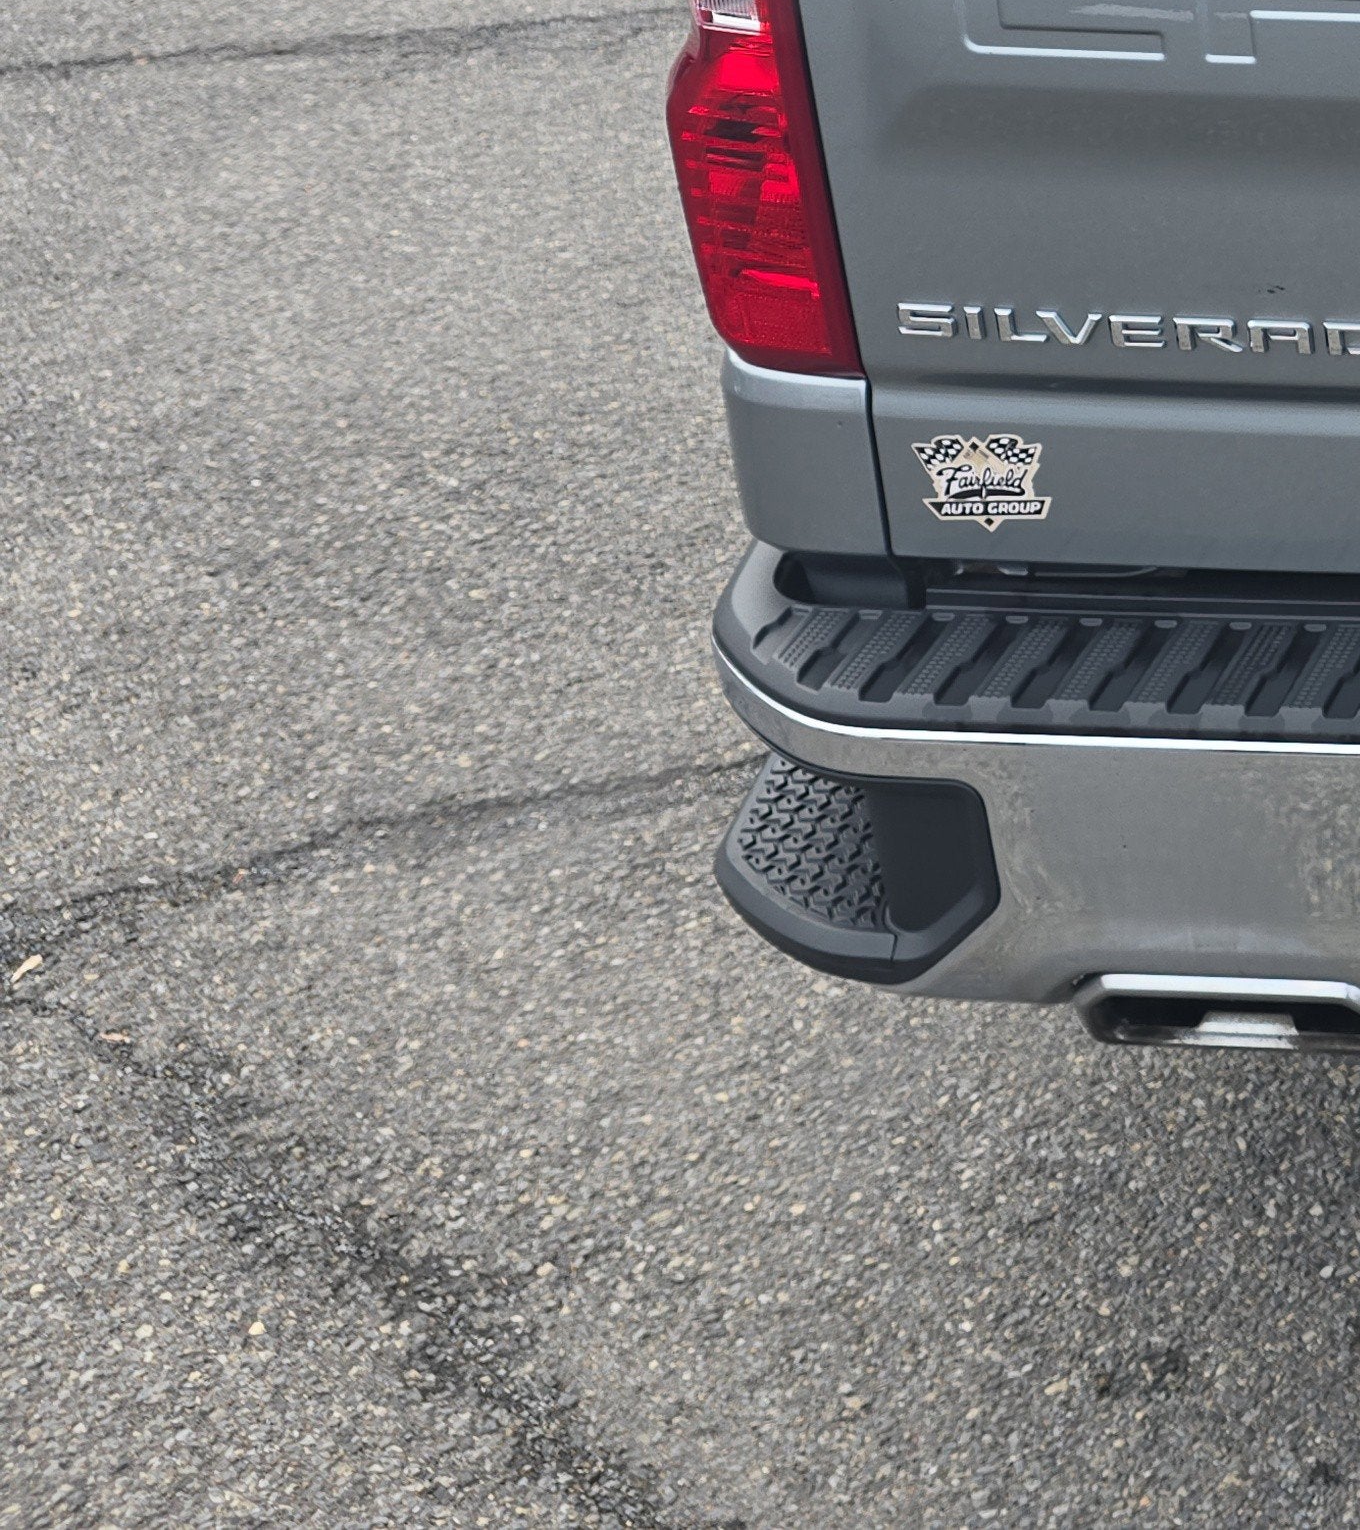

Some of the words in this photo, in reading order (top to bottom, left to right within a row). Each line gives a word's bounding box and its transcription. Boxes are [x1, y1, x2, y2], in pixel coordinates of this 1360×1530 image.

[936, 464, 1028, 499] Fairfield
[940, 501, 984, 515] AUTO
[987, 501, 1042, 515] GROUP
